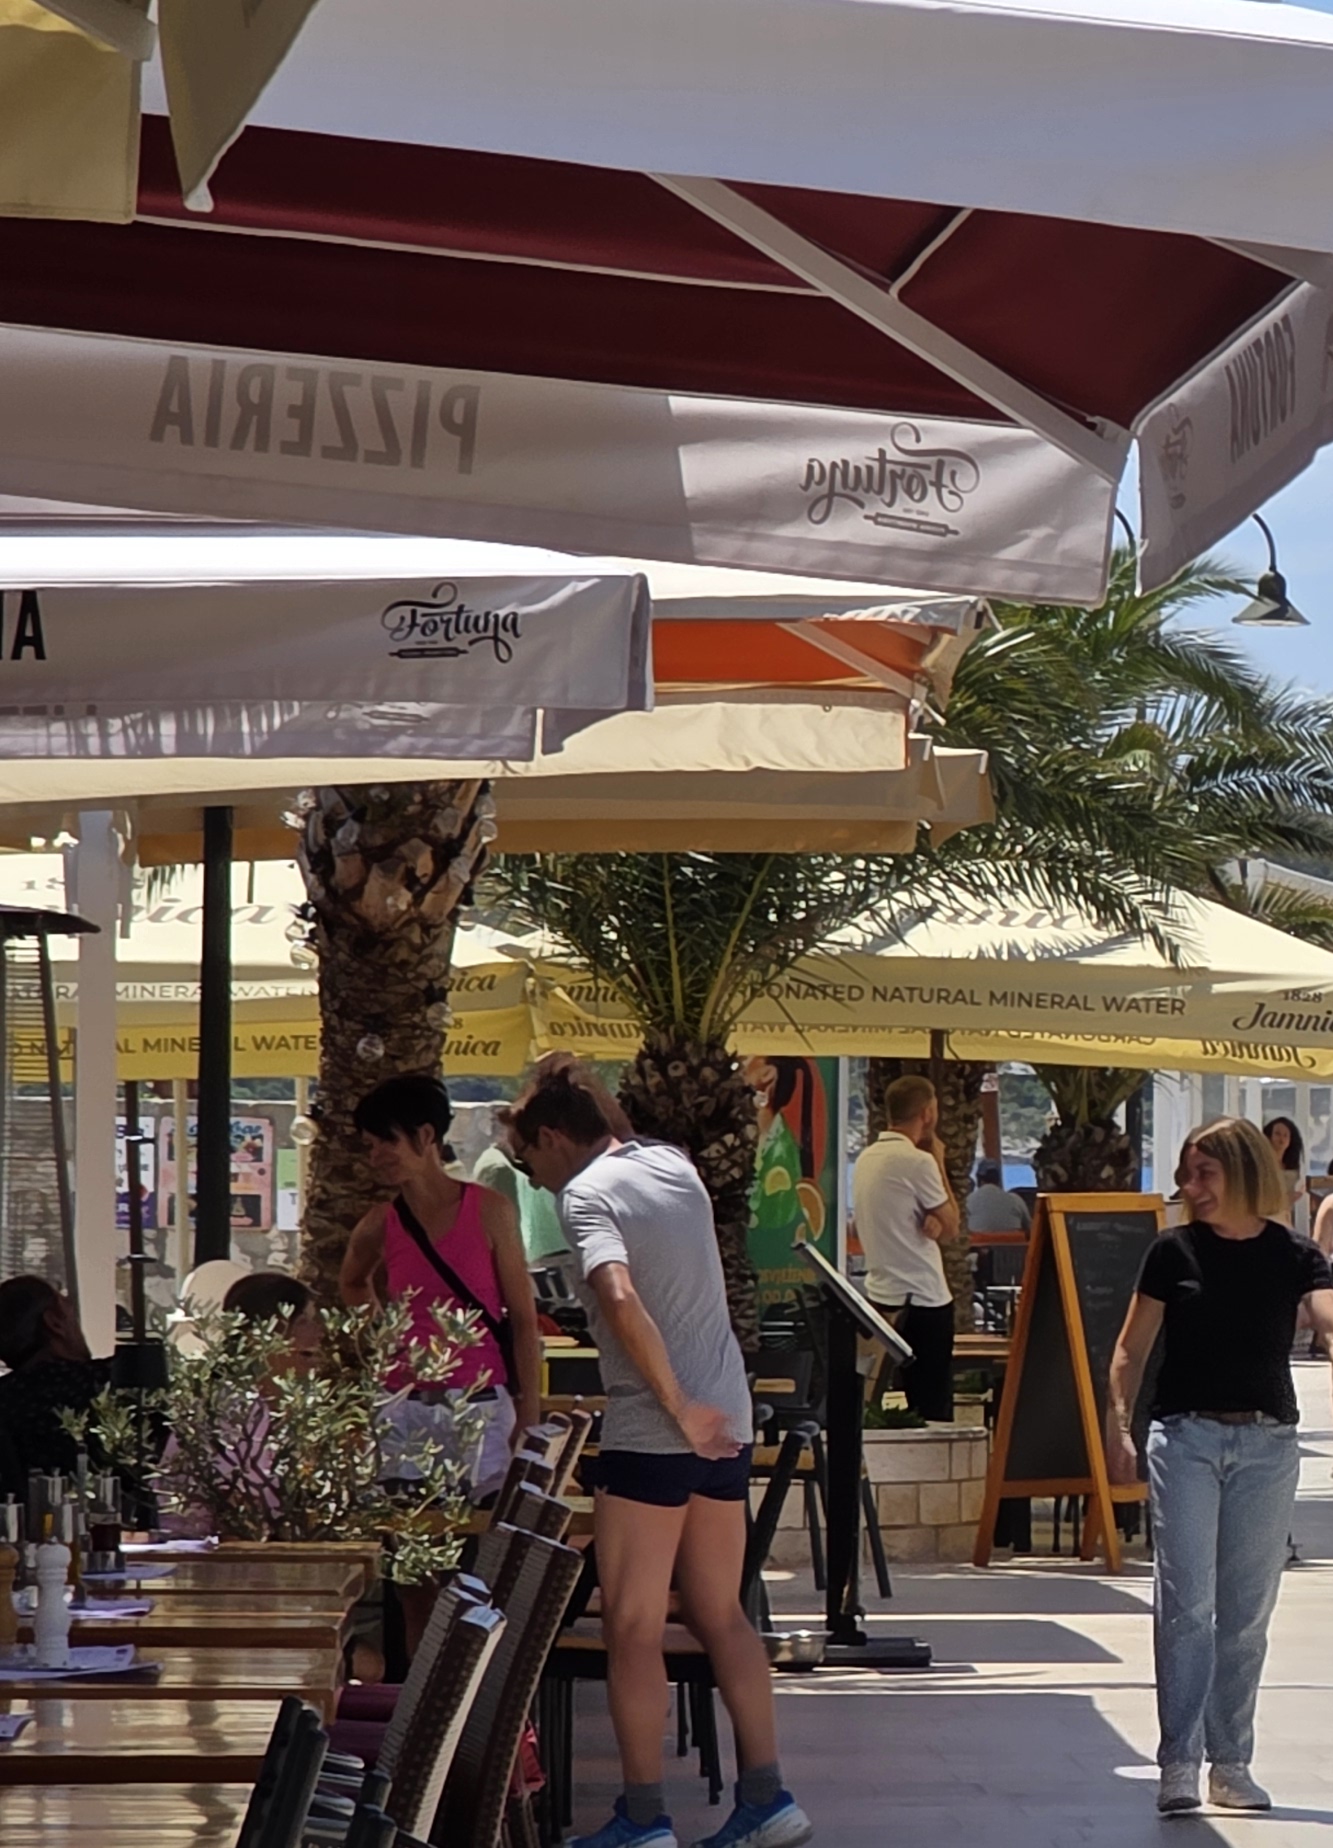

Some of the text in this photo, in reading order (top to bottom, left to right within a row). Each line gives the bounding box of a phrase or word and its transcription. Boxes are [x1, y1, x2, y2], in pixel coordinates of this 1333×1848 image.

[378, 582, 523, 664] Fortuna
[116, 984, 202, 999] MINERA
[872, 986, 983, 1006] NATURAL
[989, 990, 1095, 1012] MINERAL
[1100, 994, 1187, 1016] WATER
[142, 1035, 246, 1054] MINEL
[250, 1033, 322, 1052] WATE
